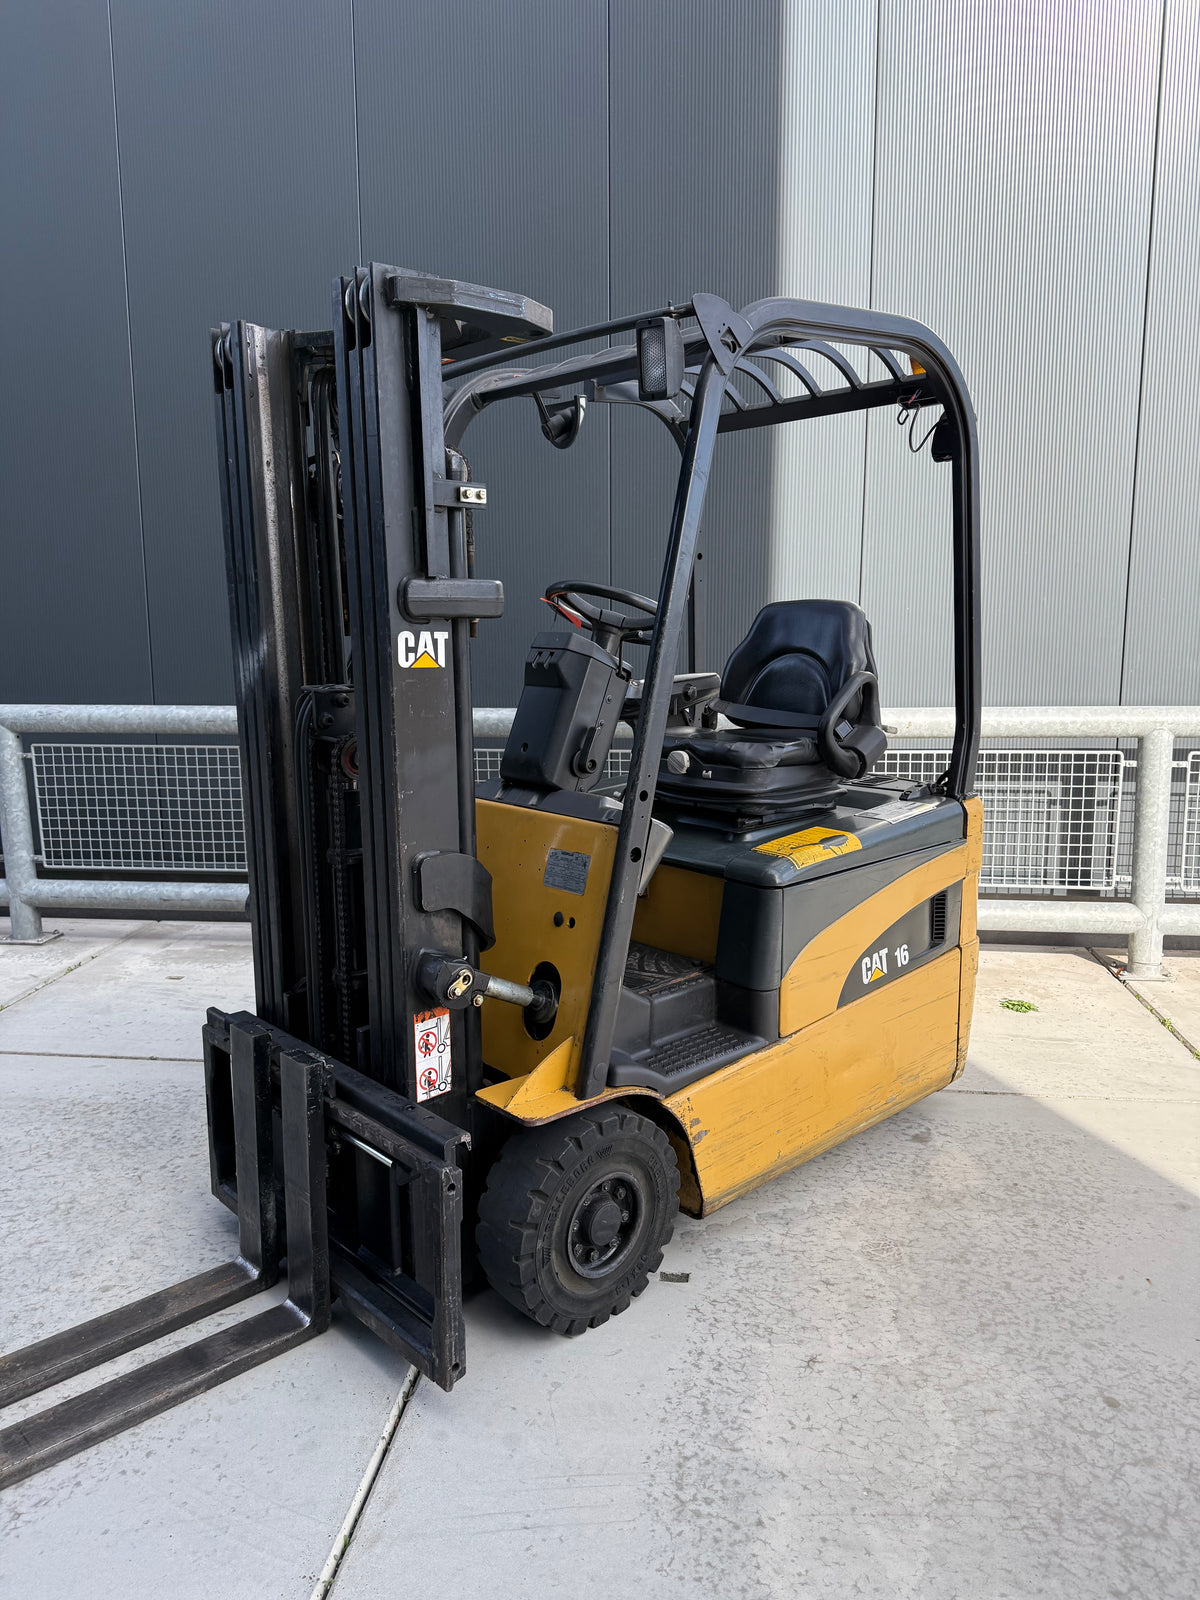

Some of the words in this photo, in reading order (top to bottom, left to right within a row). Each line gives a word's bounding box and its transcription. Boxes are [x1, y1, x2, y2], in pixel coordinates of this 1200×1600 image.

[397, 630, 449, 669] CAT
[861, 947, 889, 985] CAT
[894, 943, 910, 968] 16
